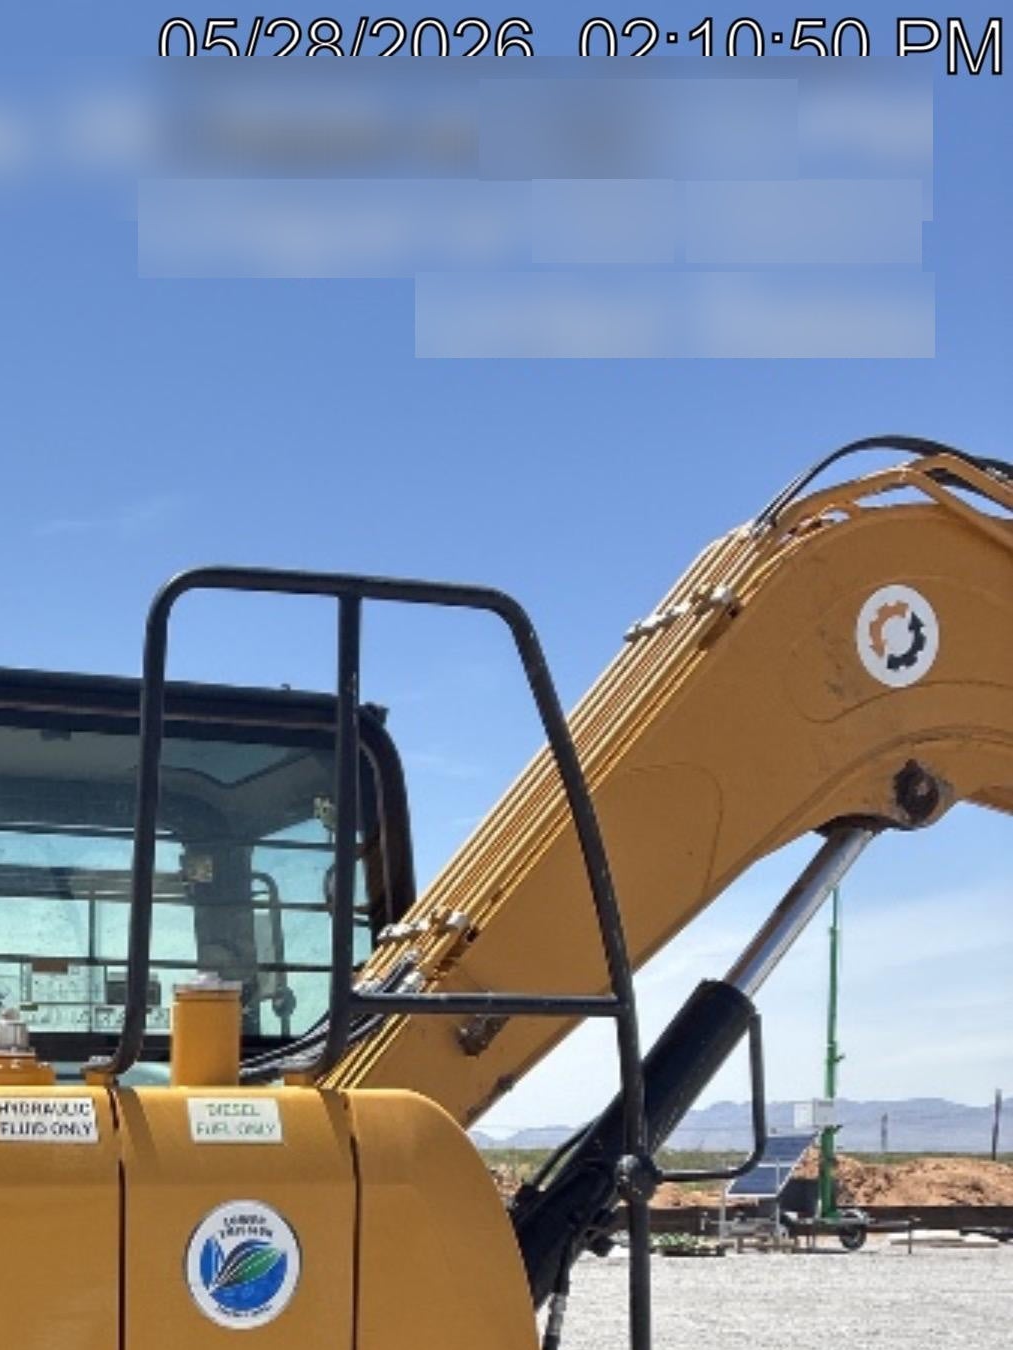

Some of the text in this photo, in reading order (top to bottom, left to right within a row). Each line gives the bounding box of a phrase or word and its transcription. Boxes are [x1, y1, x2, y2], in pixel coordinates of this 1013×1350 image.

[206, 1103, 261, 1117] DIESEL
[0, 1120, 93, 1136] FLUID ONLY
[196, 1121, 276, 1136] FUEL ONLY
